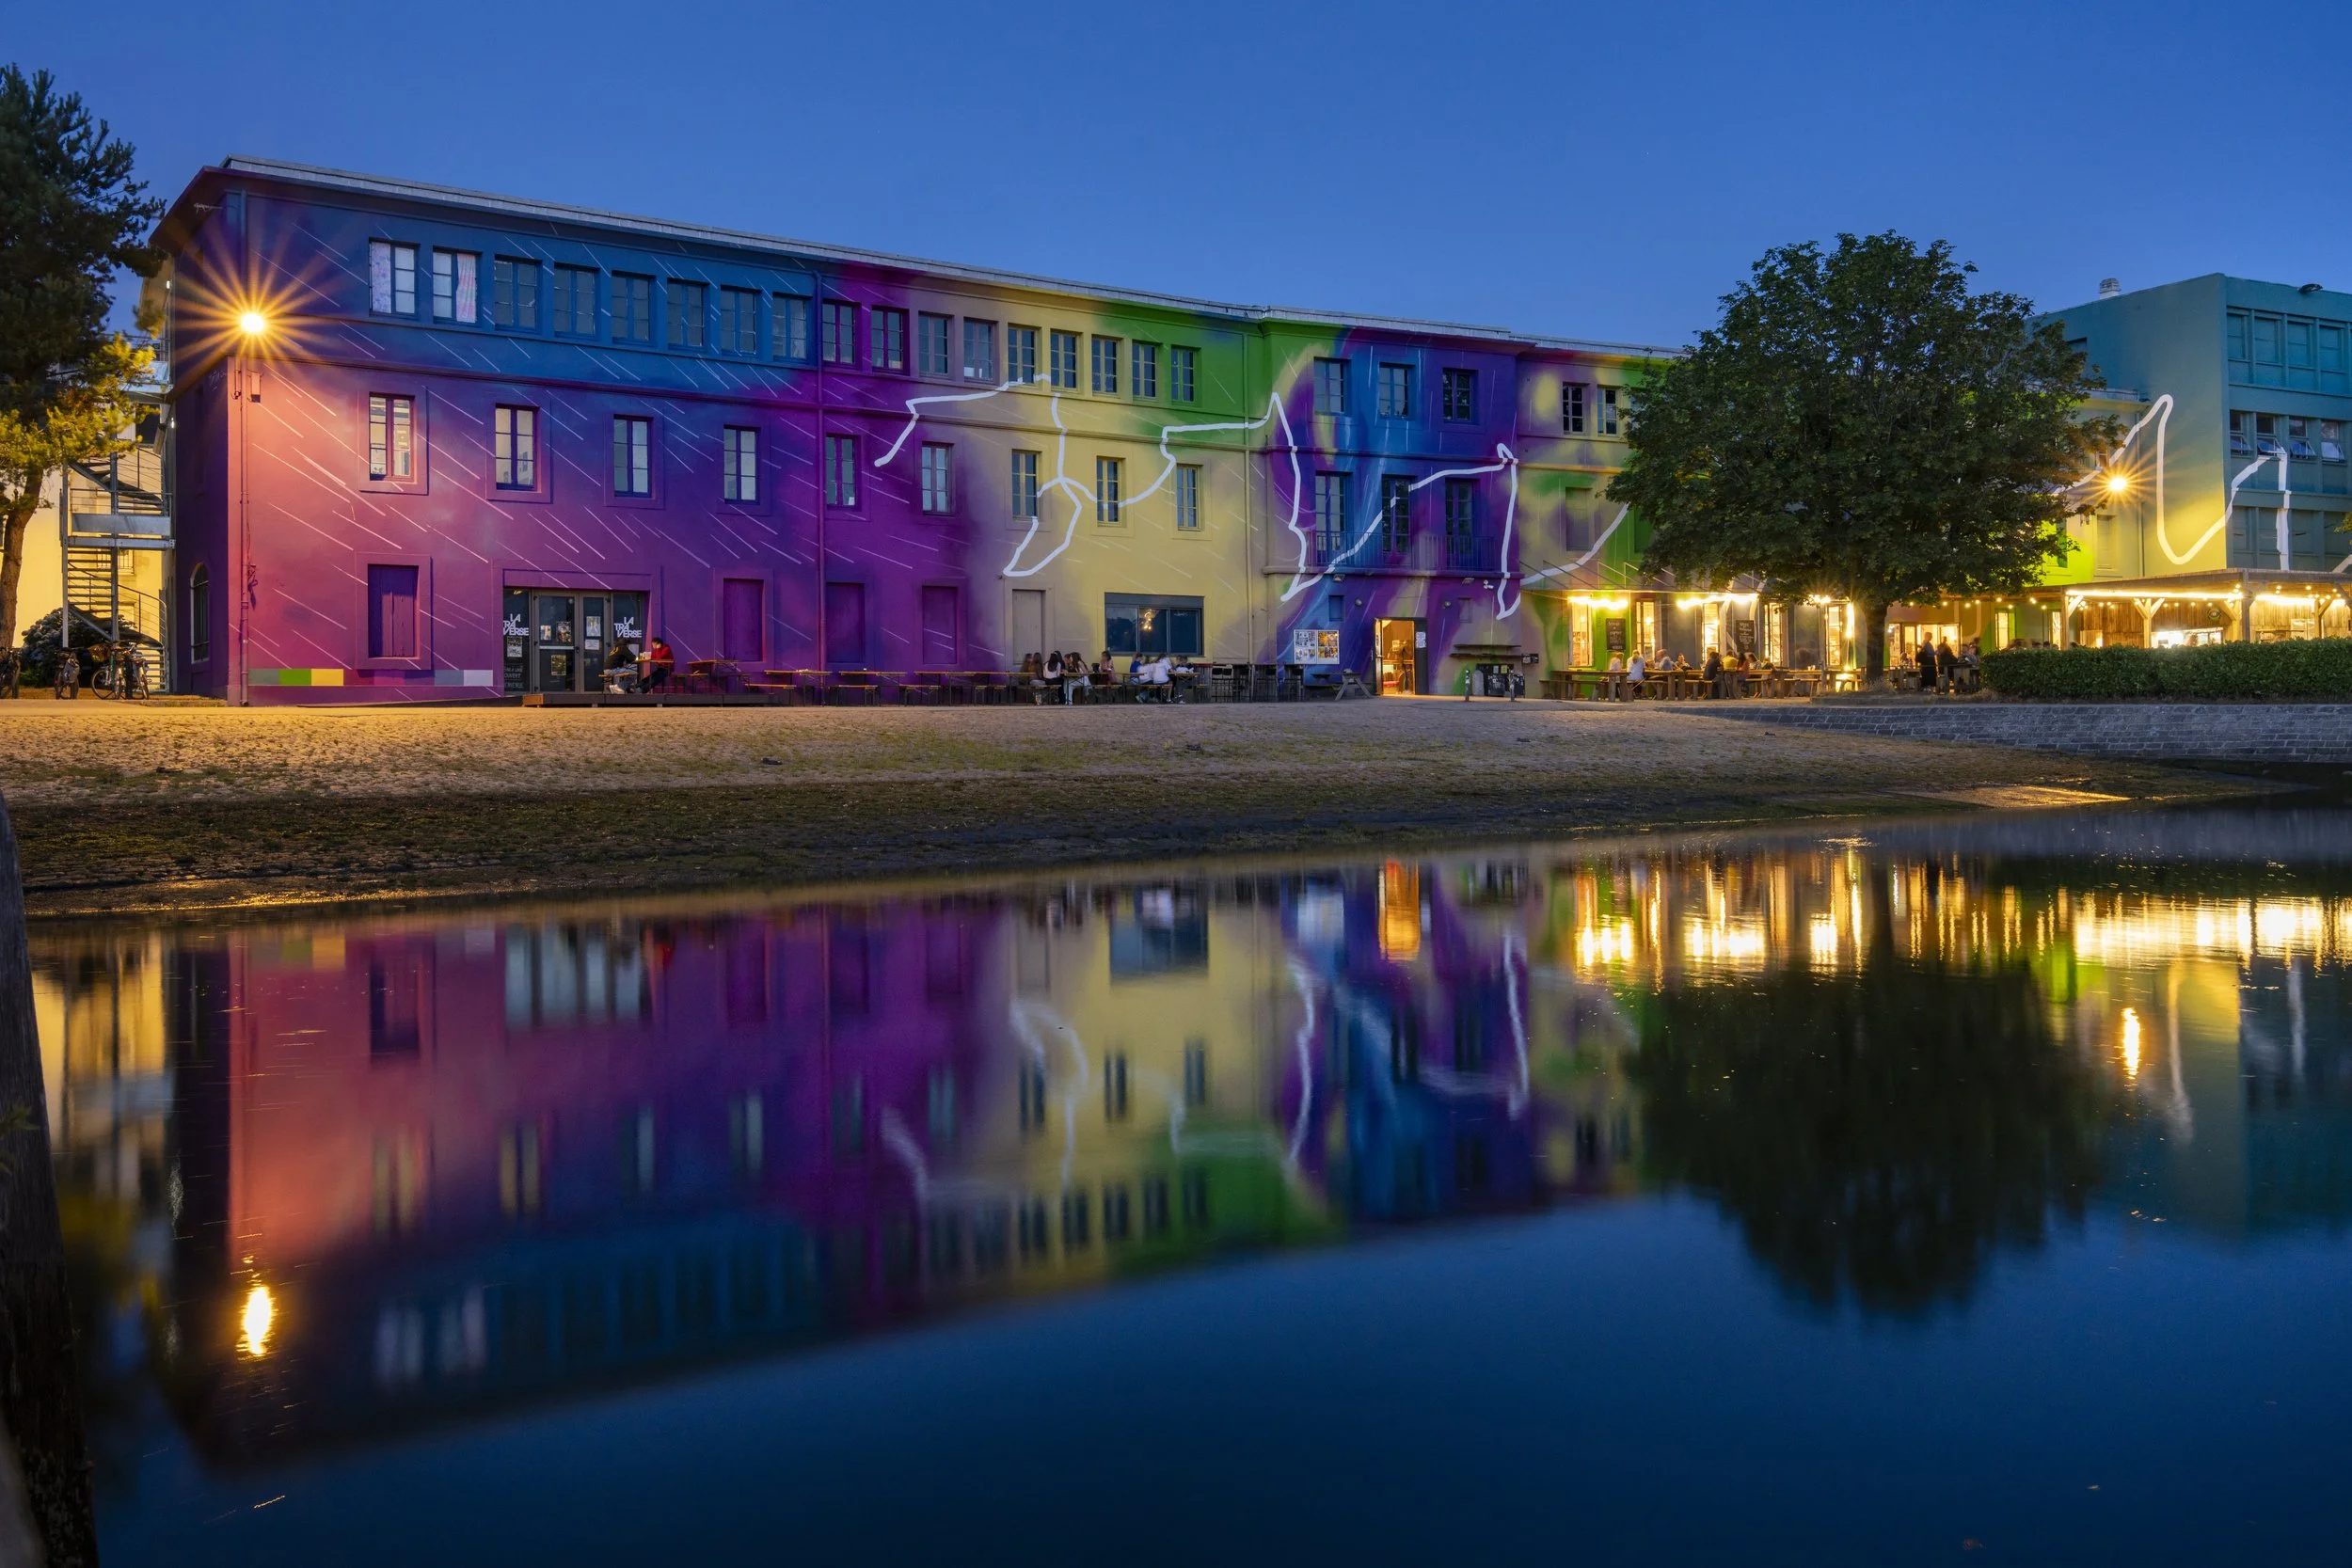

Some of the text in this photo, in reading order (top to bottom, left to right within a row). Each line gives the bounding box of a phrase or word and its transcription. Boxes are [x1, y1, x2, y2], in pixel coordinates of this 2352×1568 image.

[510, 613, 521, 622] LA
[624, 616, 634, 625] LA
[503, 627, 530, 636] VERSE
[613, 623, 629, 631] TRA
[617, 629, 642, 638] VERSE
